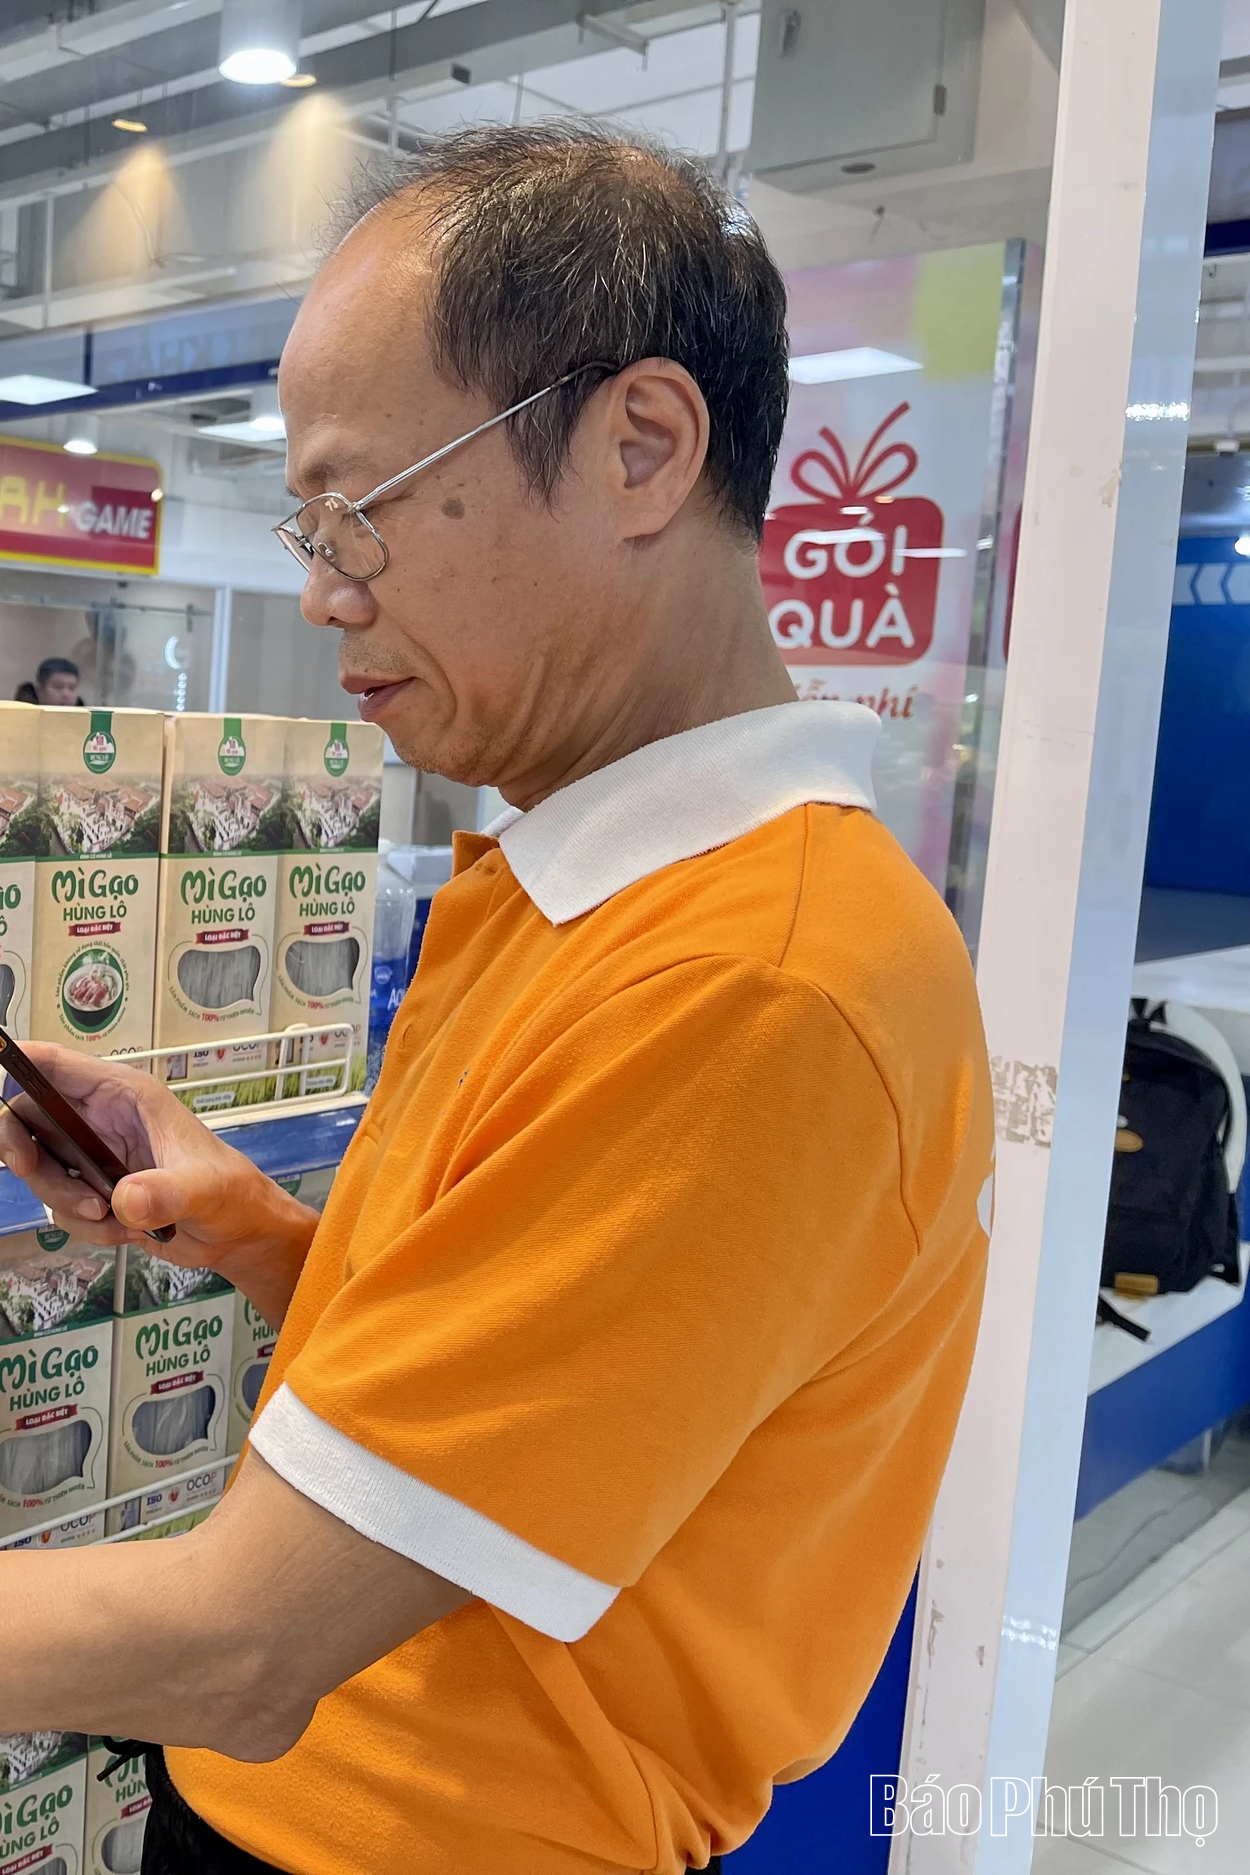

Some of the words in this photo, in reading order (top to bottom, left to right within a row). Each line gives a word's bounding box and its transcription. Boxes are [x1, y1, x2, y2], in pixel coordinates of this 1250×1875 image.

[74, 501, 154, 539] GAME
[769, 585, 915, 649] QUÀ
[89, 869, 138, 900] Gạo
[218, 869, 267, 903] Gạo
[63, 903, 106, 921] HÙNG
[110, 901, 127, 918] LÔ
[191, 905, 235, 924] HÙNG
[238, 902, 255, 921] LÔ
[299, 899, 338, 916] HÙNG
[341, 896, 355, 914] LÔ
[172, 1315, 223, 1346] Gạo
[41, 1345, 98, 1380] Gạo
[146, 1353, 189, 1377] HÙNG
[193, 1344, 211, 1365] LÔ
[10, 1385, 60, 1412] HÙNG
[65, 1376, 84, 1397] LÔ
[155, 1458, 174, 1469] 100%
[147, 1493, 163, 1506] ISO
[186, 1471, 218, 1492] OCOP
[16, 1785, 73, 1828] Gạo
[40, 1816, 59, 1841] LÔ
